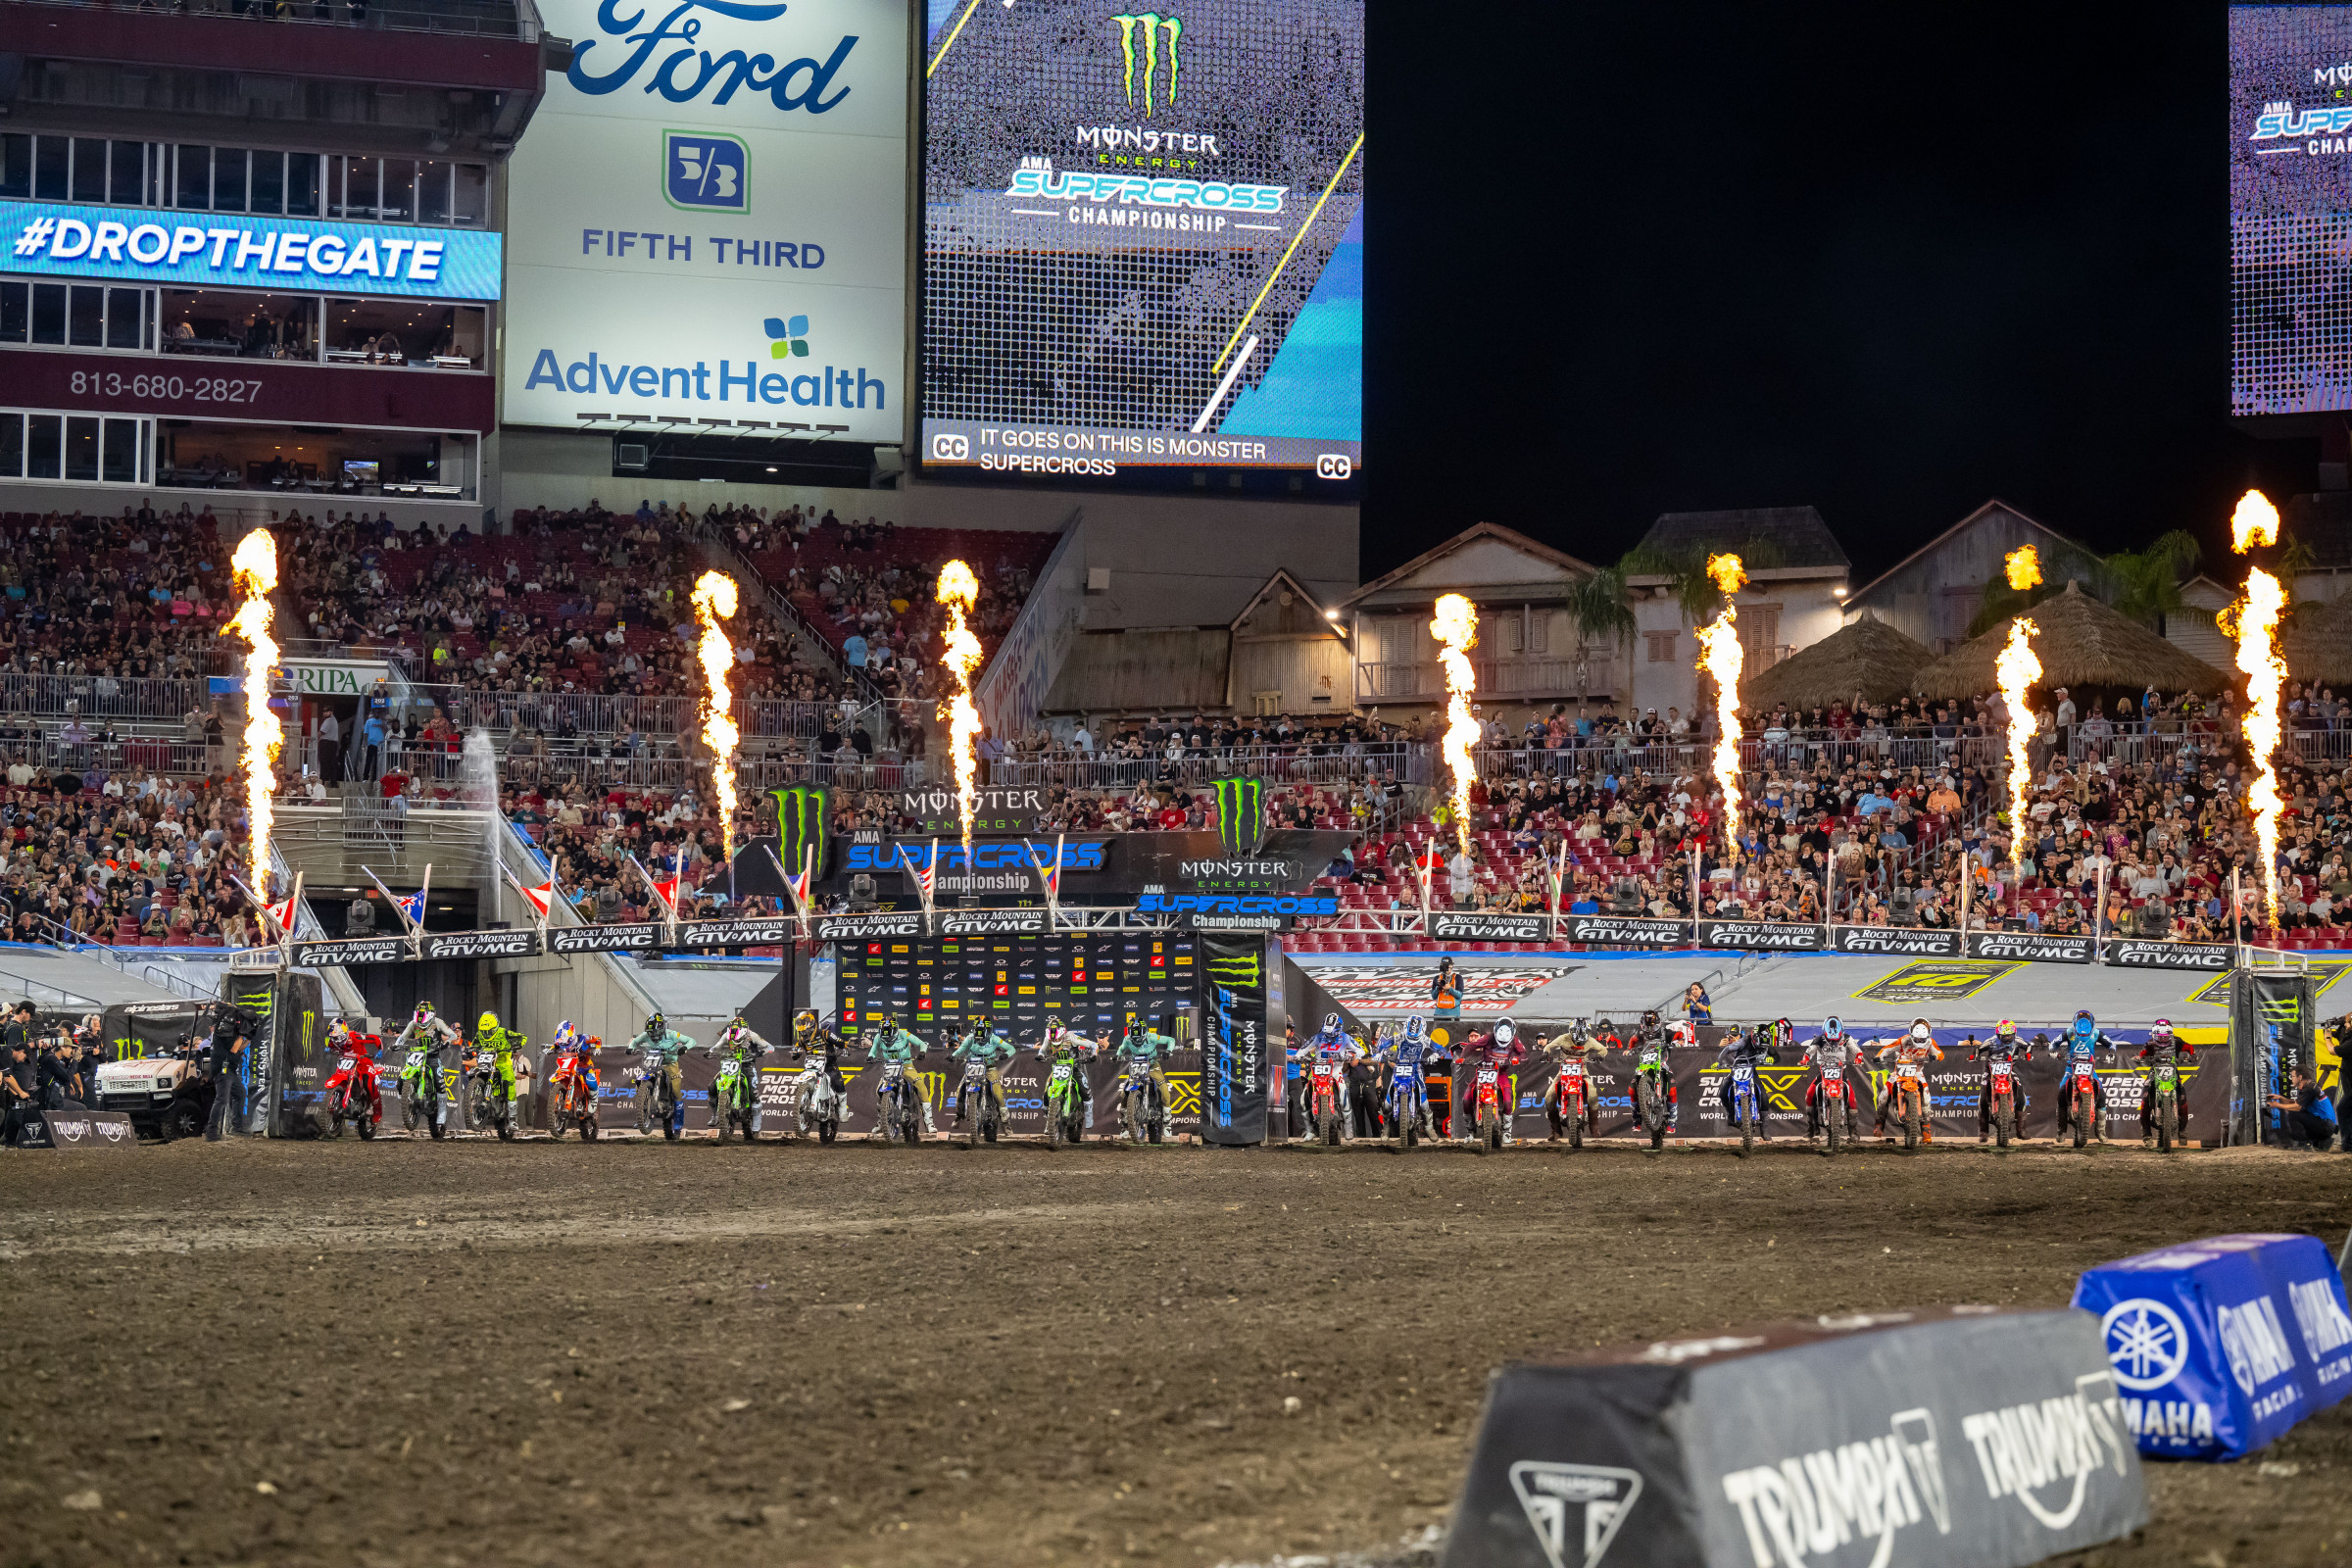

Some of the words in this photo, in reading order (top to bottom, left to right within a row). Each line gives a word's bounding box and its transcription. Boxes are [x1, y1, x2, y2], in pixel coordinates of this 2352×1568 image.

[565, 0, 860, 114] Ford
[2263, 101, 2293, 114] AMA
[1076, 124, 1219, 155] MONSTER
[1020, 156, 1053, 171] AMA
[1099, 153, 1199, 170] ENERGY
[1004, 171, 1289, 213] SUPERCROSS
[1069, 207, 1227, 232] CHAMPIONSHIP
[14, 217, 445, 281] #DROPTHEGATE
[582, 228, 692, 262] FIFTH
[710, 237, 825, 270] THIRD
[525, 348, 885, 410] AdventHealth
[70, 371, 263, 403] 813-680-2827
[935, 436, 967, 458] CC
[981, 429, 1003, 446] IT
[1005, 430, 1058, 451] GOES
[1064, 433, 1096, 451] ON
[1098, 435, 1143, 454] THIS
[1148, 437, 1164, 454] IS
[1168, 439, 1266, 460] MONSTER
[980, 454, 1116, 476] SUPERCROSS
[1318, 456, 1350, 477] CC
[298, 667, 361, 694] RIPA
[927, 819, 1022, 830] ENRGY
[854, 831, 880, 844] AMA
[846, 844, 1105, 870] SUPERCROSS
[1182, 858, 1288, 877] MONSTER
[1144, 885, 1165, 894] AMA
[1136, 895, 1340, 914] SUPERCROSS
[868, 915, 918, 924] MOUNTAIN
[992, 911, 1043, 920] MOUNTAIN
[1192, 914, 1281, 930] Championship
[1451, 915, 1485, 924] ROCKY
[1486, 916, 1540, 926] MOUNTAIN
[699, 923, 731, 932] ROCKY
[1592, 918, 1624, 928] ROCKY
[1626, 920, 1680, 931] MOUNTAIN
[1727, 923, 1760, 933] ROCKY
[1761, 924, 1815, 934] MOUNTAIN
[569, 928, 601, 937] ROCKY
[603, 926, 653, 936] MOUNTAIN
[1862, 929, 1894, 938] ROCKY
[1895, 931, 1950, 941] MOUNTAIN
[446, 935, 476, 944] ROCKY
[478, 934, 528, 943] MOUNTAIN
[1996, 935, 2030, 945] ROCKY
[2032, 937, 2085, 947] MOUNTAIN
[315, 944, 344, 953] ROCKY
[346, 942, 396, 952] MOUNTAIN
[2135, 943, 2170, 952] ROCKY
[2172, 944, 2227, 955] MOUNTAIN
[1320, 1043, 1343, 1052] FLY
[409, 1053, 424, 1063] 47
[478, 1054, 494, 1063] 83
[561, 1058, 572, 1069] 1
[806, 1059, 825, 1069] 24
[1219, 988, 1232, 1127] SUPERCROSS
[1244, 1020, 1257, 1095] MONSTER
[257, 1040, 268, 1093] MONSTER
[339, 1059, 355, 1070] 10
[1314, 1065, 1331, 1075] 60
[1396, 1066, 1413, 1076] 92
[1561, 1064, 1582, 1076] 55
[1896, 1065, 1918, 1076] 75
[1990, 1063, 2011, 1075] 195
[2075, 1063, 2093, 1076] 89
[1053, 1065, 1071, 1078] 56
[1478, 1070, 1498, 1083] 59
[1735, 1067, 1751, 1081] 87
[1824, 1068, 1840, 1078] 125
[2158, 1067, 2174, 1077] 73
[762, 1085, 798, 1095] MOT
[2104, 1087, 2142, 1097] OTO
[54, 1121, 85, 1140] TRIUMPH
[96, 1121, 125, 1140] TRIUMPH
[1963, 1394, 2104, 1529] TRIUMPH
[1722, 1435, 1923, 1568] TRIUMPH
